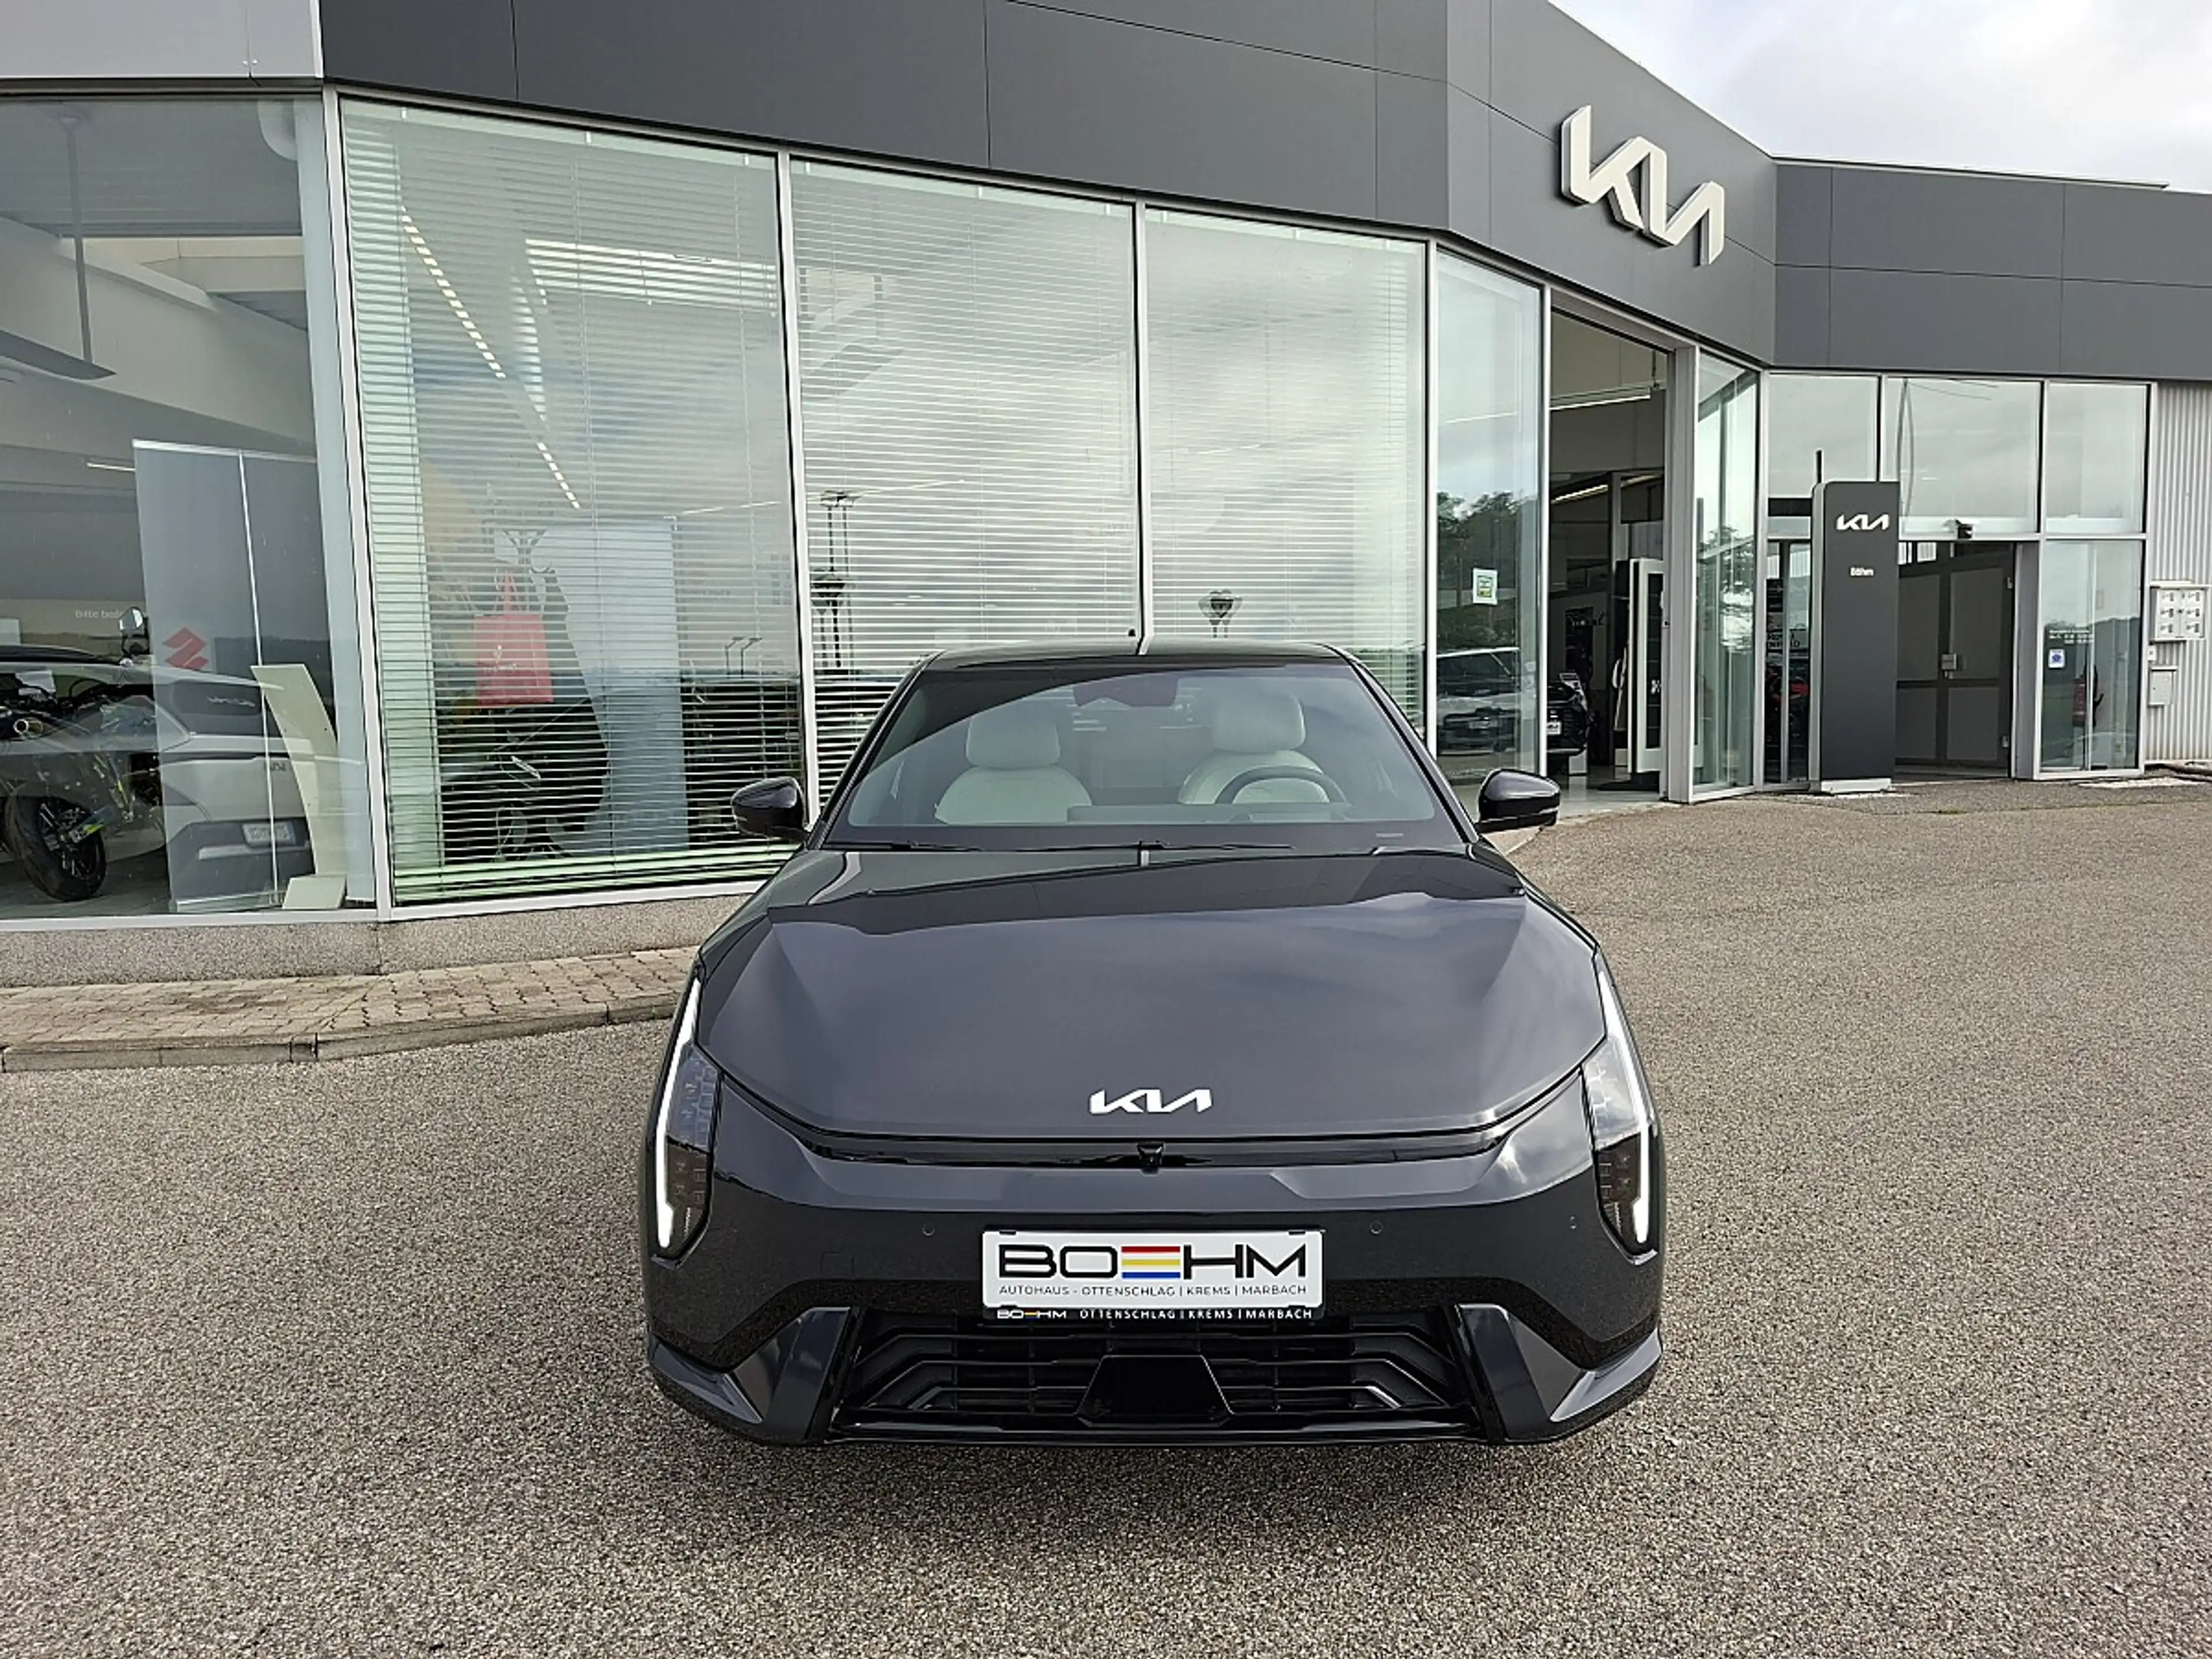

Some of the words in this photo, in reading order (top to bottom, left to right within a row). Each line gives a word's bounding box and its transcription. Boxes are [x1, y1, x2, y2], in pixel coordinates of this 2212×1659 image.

[1561, 105, 1725, 266] KIA
[1836, 514, 1889, 530] KIA
[1090, 1089, 1213, 1114] KIA
[999, 1285, 1070, 1295] AUTOHAUS
[1082, 1286, 1175, 1296] OTTENSCHLAG
[1187, 1286, 1231, 1296] KREMS
[1242, 1285, 1306, 1295] MARBACH
[1080, 1309, 1175, 1319] OTTENSCHLAG
[1188, 1309, 1233, 1319] KREMS
[1246, 1309, 1312, 1319] MARBACH
